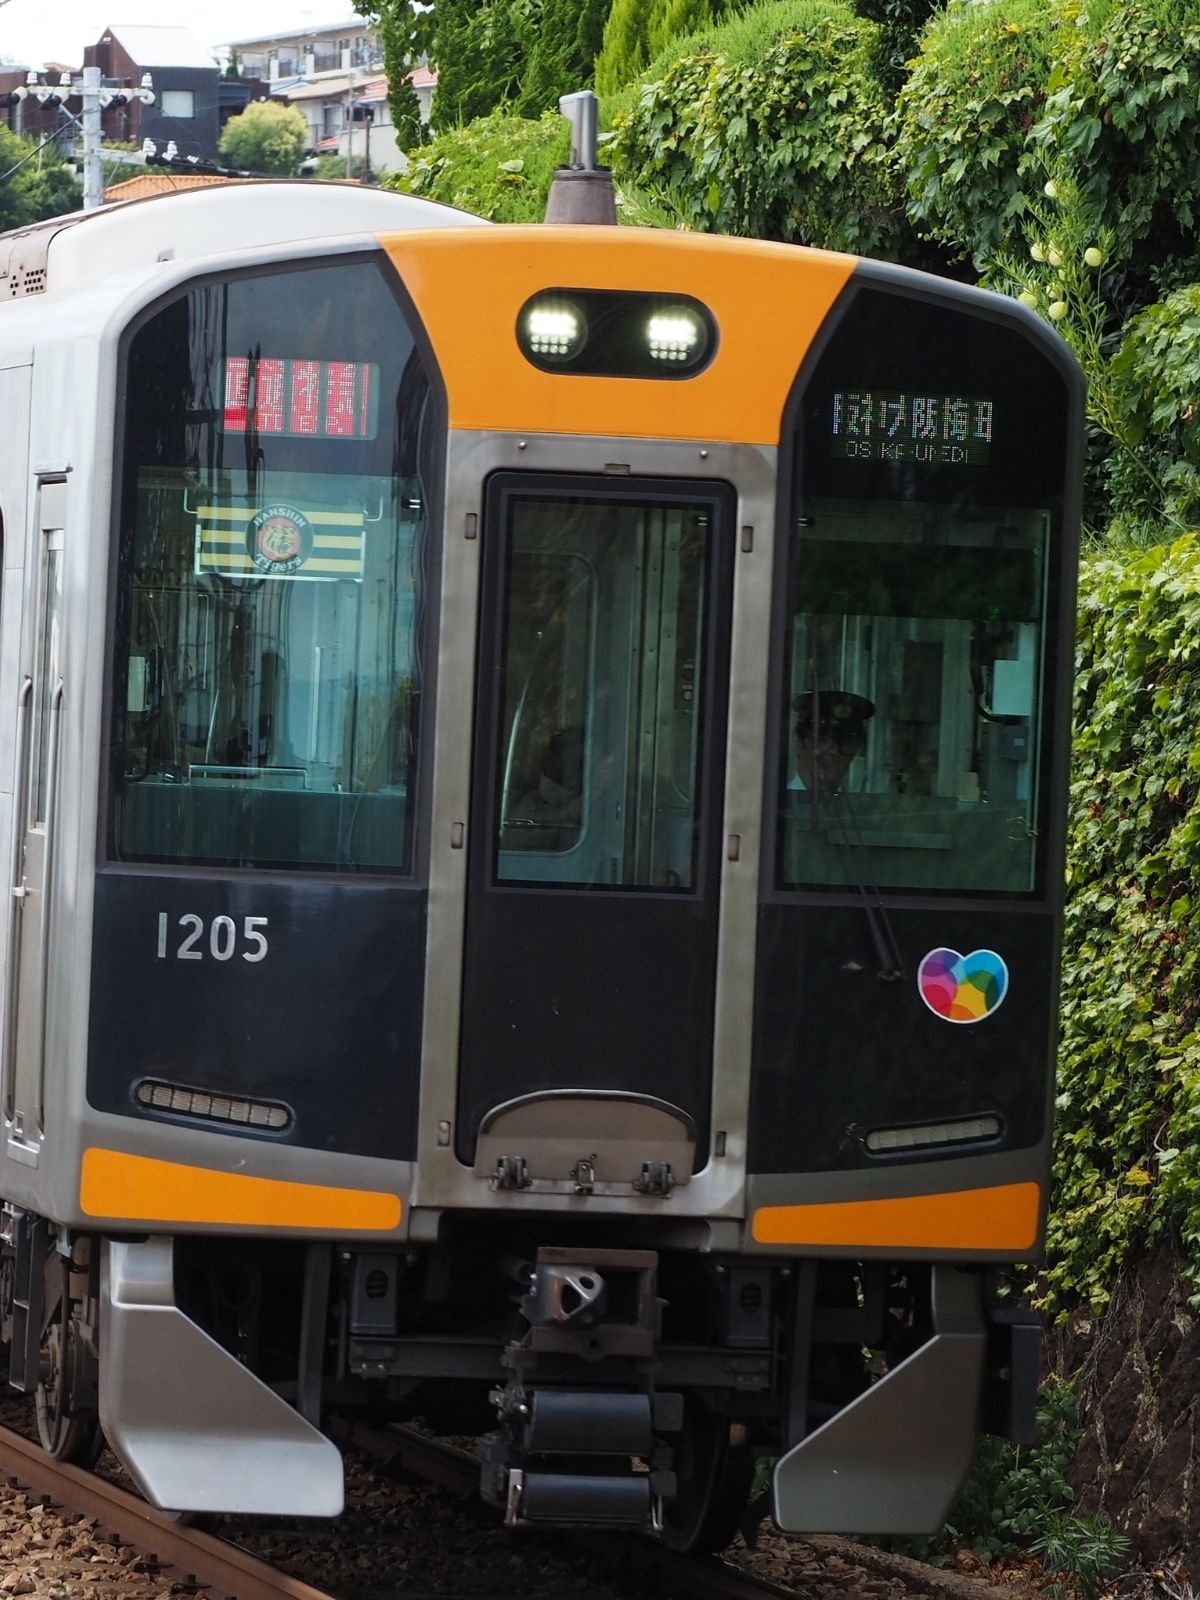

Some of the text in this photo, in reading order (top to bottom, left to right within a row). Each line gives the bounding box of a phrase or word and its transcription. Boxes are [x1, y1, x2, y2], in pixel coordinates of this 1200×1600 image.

[253, 508, 306, 528] HANSHIN
[256, 553, 302, 572] Tigers
[157, 912, 269, 962] 1205
